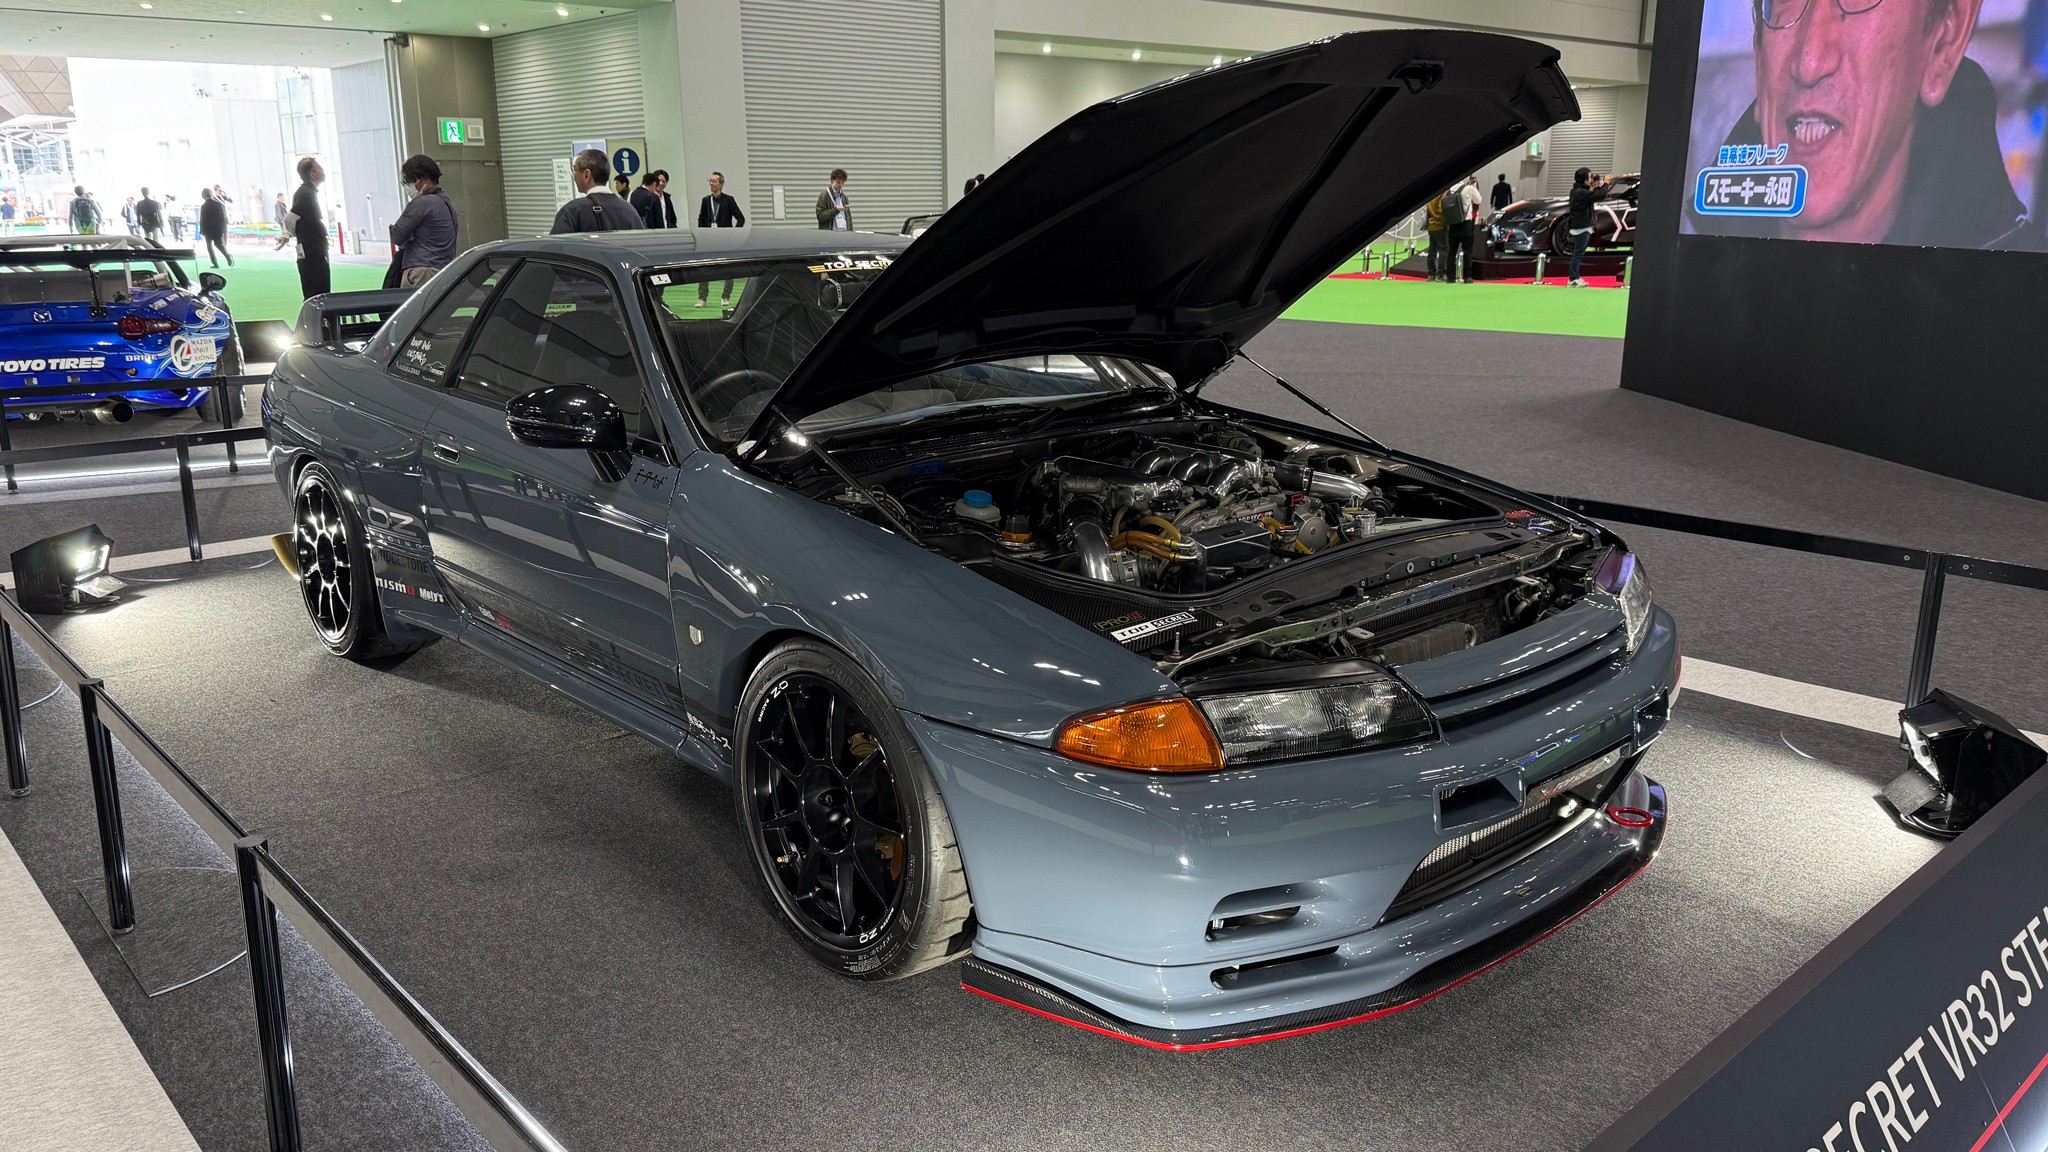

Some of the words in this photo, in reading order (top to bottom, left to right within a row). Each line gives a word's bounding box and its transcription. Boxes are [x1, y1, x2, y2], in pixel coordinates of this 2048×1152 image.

[1719, 144, 1789, 165] 最高速フリーク
[1706, 176, 1793, 205] スモーキー永田
[48, 356, 106, 370] TIRES
[1117, 624, 1150, 637] TOP
[1153, 612, 1191, 629] SECRET
[1927, 969, 2016, 1082] VR32
[2001, 906, 2048, 1008] STE
